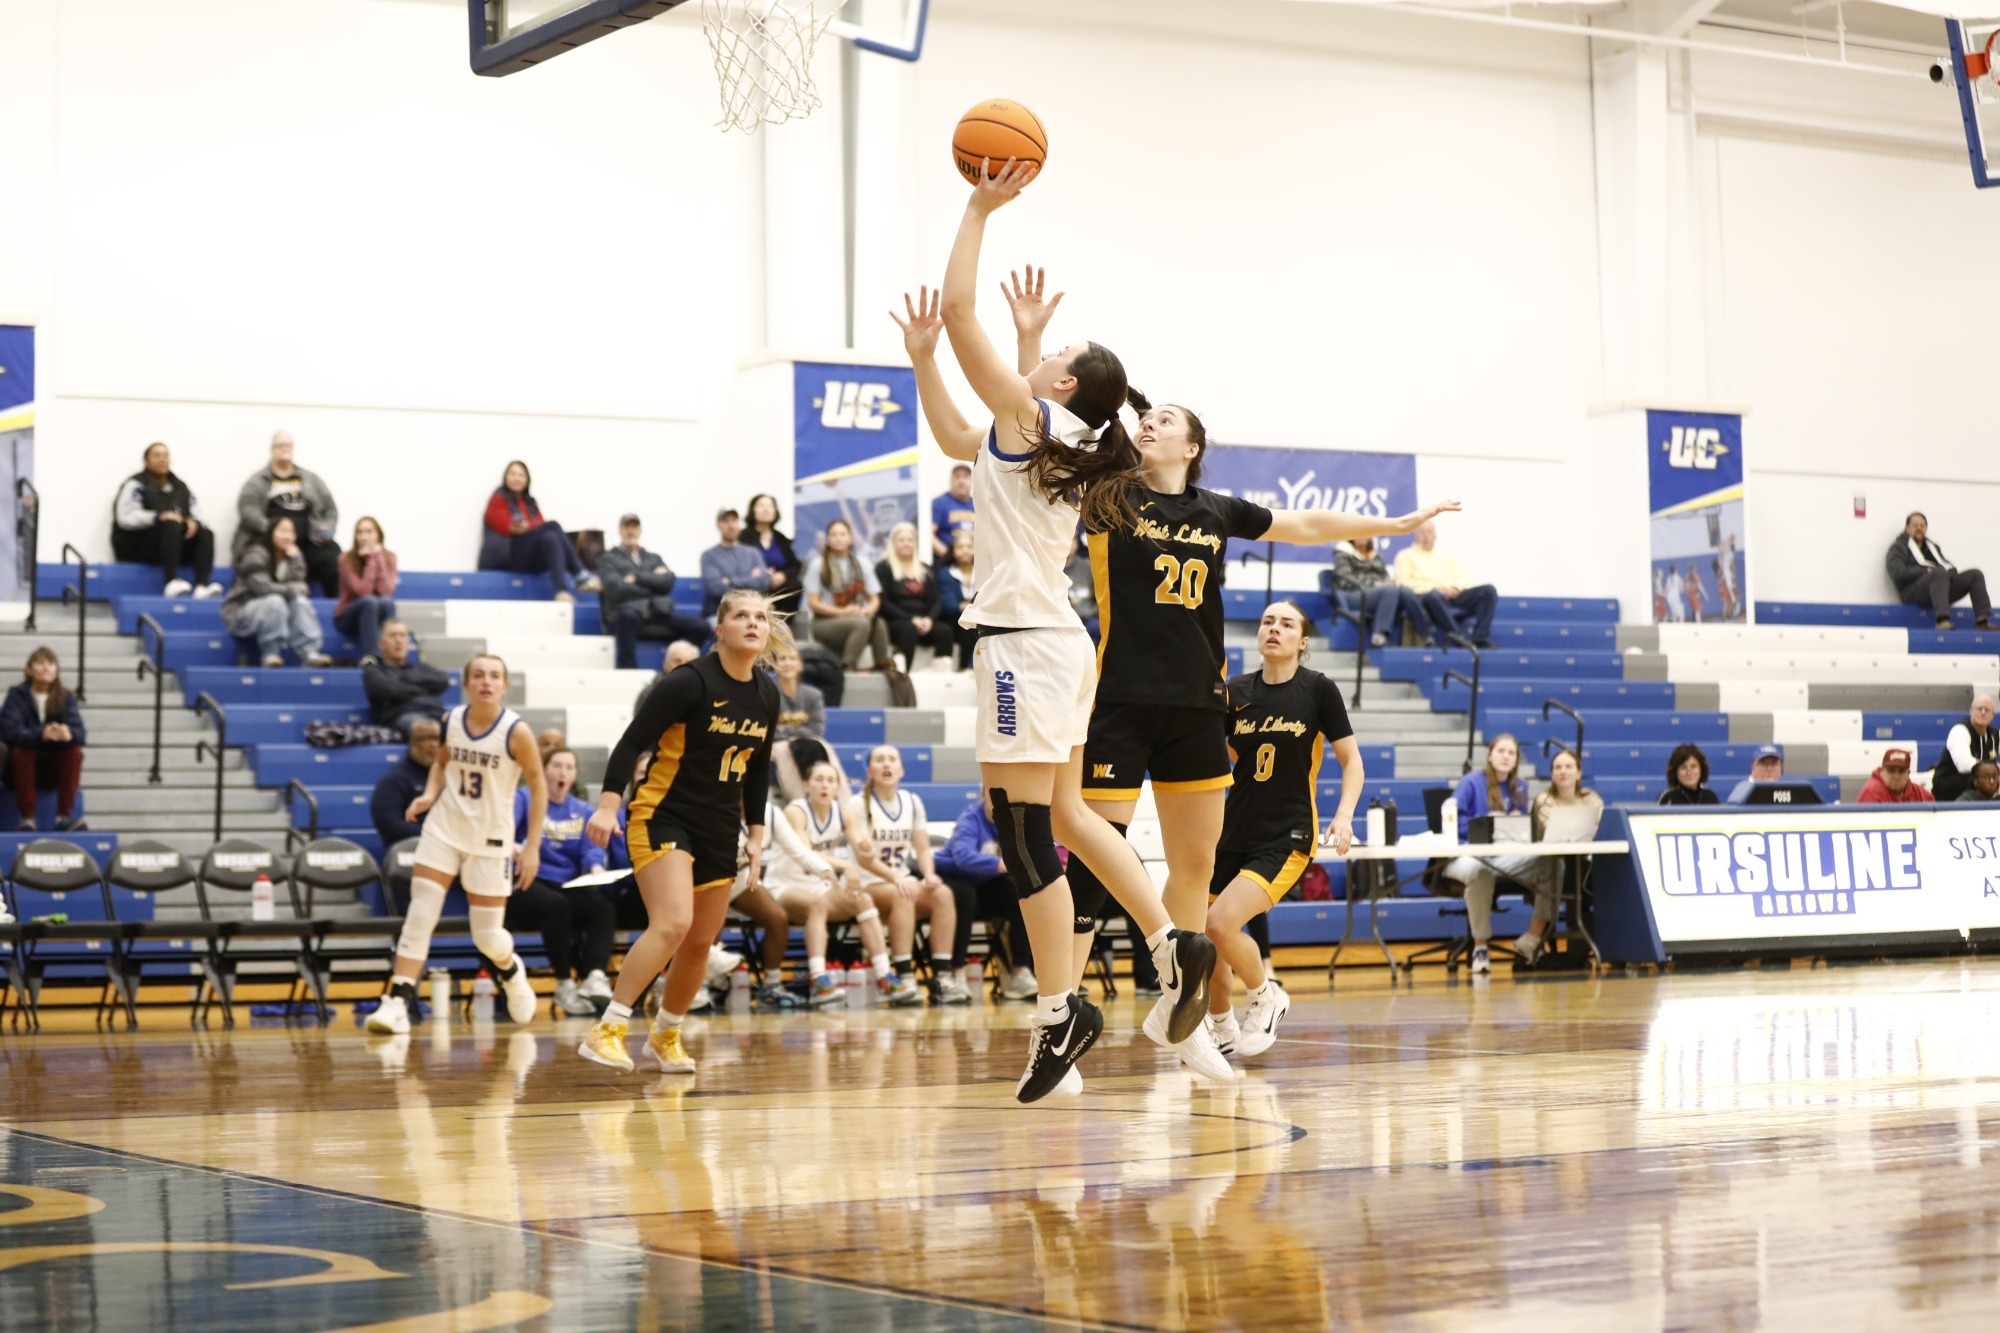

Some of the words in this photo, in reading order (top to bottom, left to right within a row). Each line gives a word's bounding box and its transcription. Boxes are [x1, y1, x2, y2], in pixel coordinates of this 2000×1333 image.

[821, 380, 891, 430] UC
[1669, 425, 1721, 470] UC
[1133, 517, 1170, 540] West
[1154, 553, 1209, 610] 20
[995, 670, 1017, 737] ARROWS
[707, 715, 737, 734] West
[1234, 719, 1256, 735] West
[1258, 715, 1307, 737] Liberty
[449, 746, 500, 769] RROWS
[718, 745, 755, 782] 14
[1253, 743, 1276, 782] 0
[1092, 763, 1116, 779] WL
[458, 768, 483, 799] 13
[1773, 790, 1792, 803] POSS
[872, 829, 912, 841] ARROW
[880, 846, 905, 868] 25
[1657, 830, 1921, 896] URSULINE
[1761, 892, 1849, 915] ARROWS
